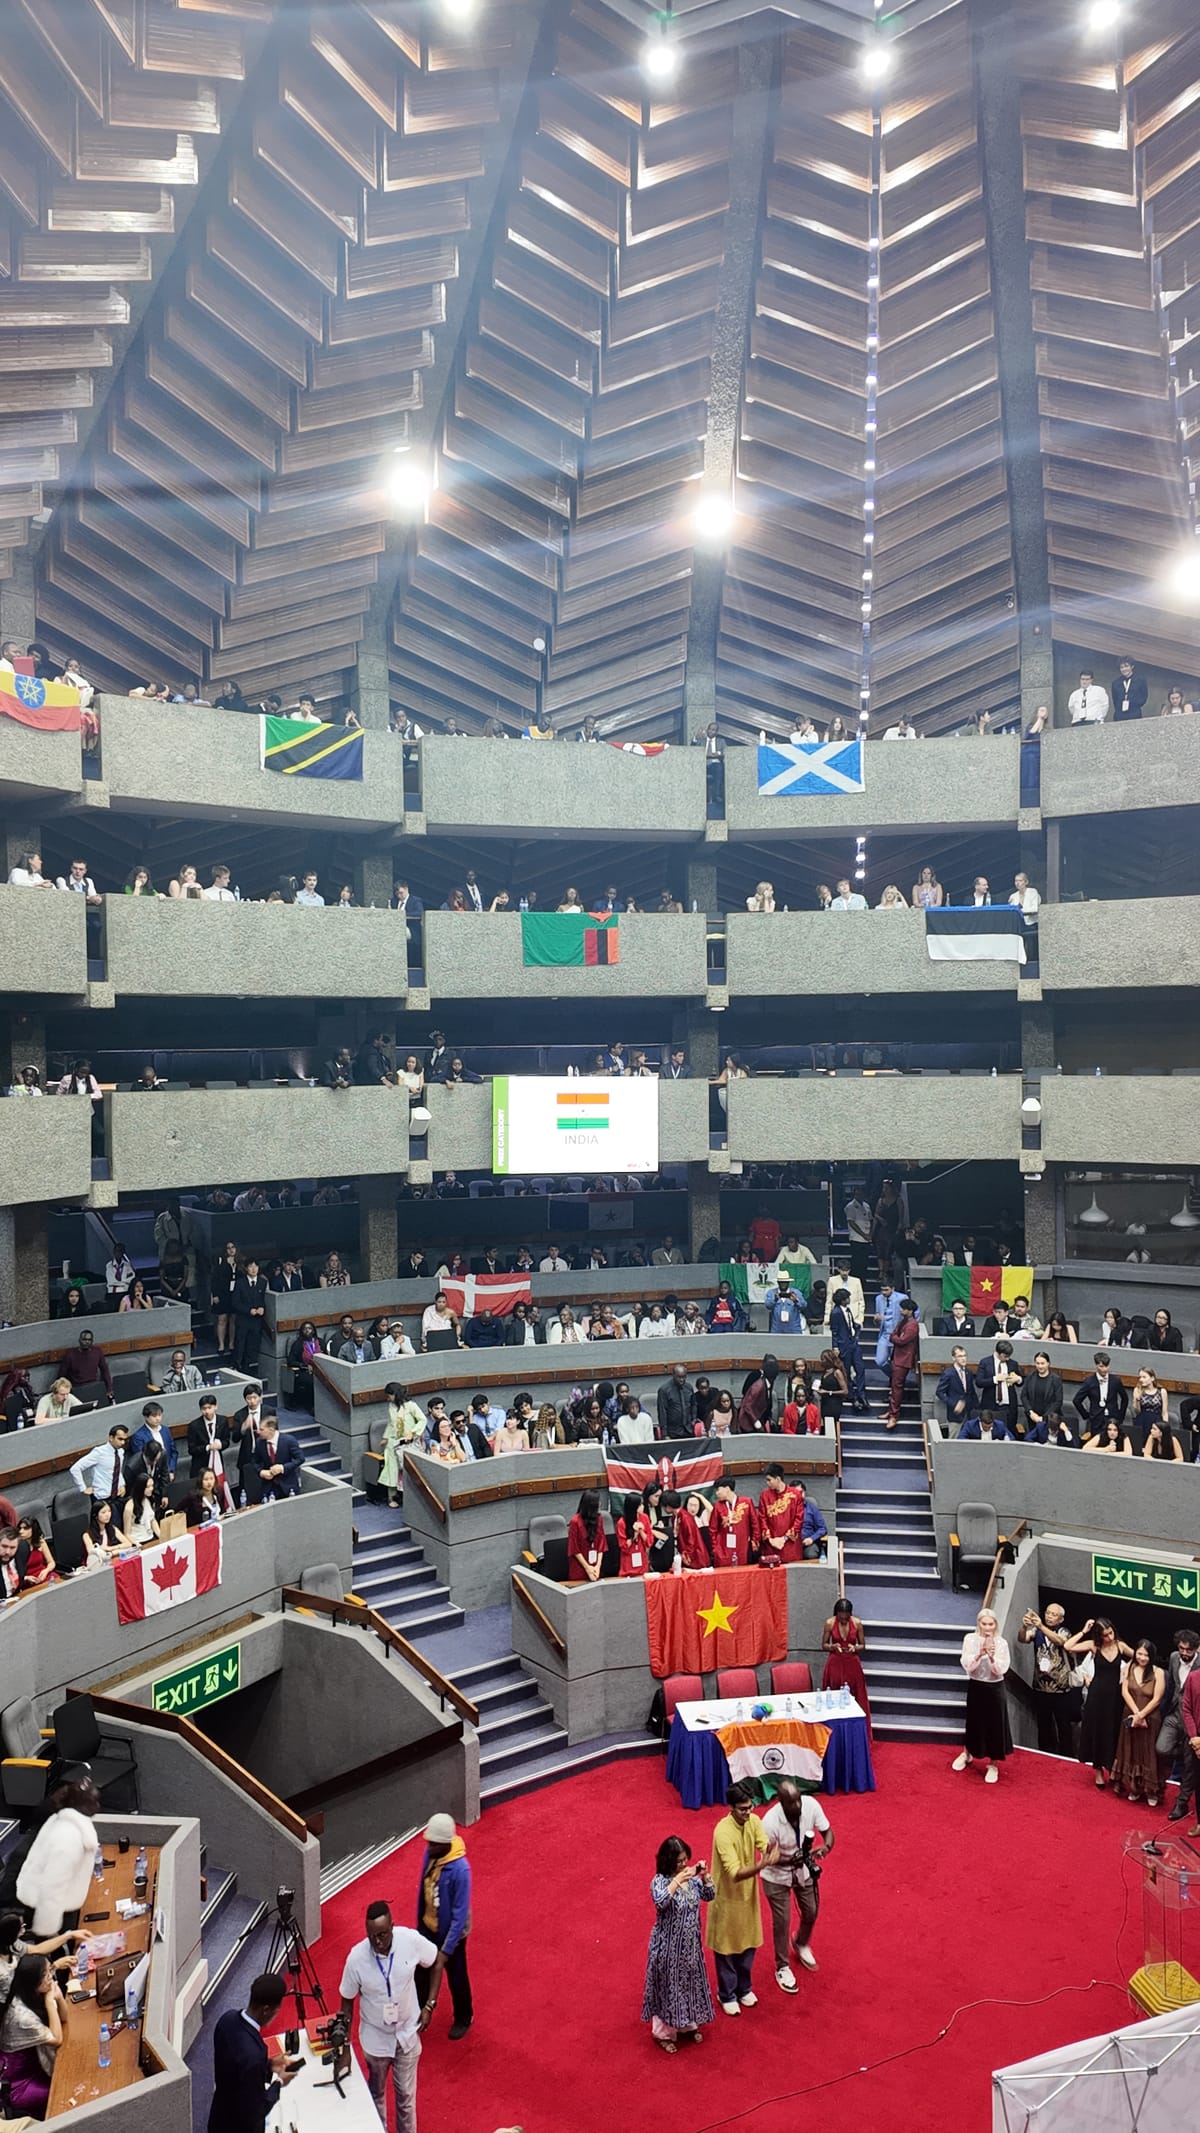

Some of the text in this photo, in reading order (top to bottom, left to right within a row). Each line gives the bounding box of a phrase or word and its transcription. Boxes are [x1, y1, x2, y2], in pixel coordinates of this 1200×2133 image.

[497, 1108, 505, 1147] CATEGORY
[564, 1134, 599, 1145] INDIA
[1096, 1565, 1148, 1591] EXIT
[155, 1675, 201, 1712] EXIT
